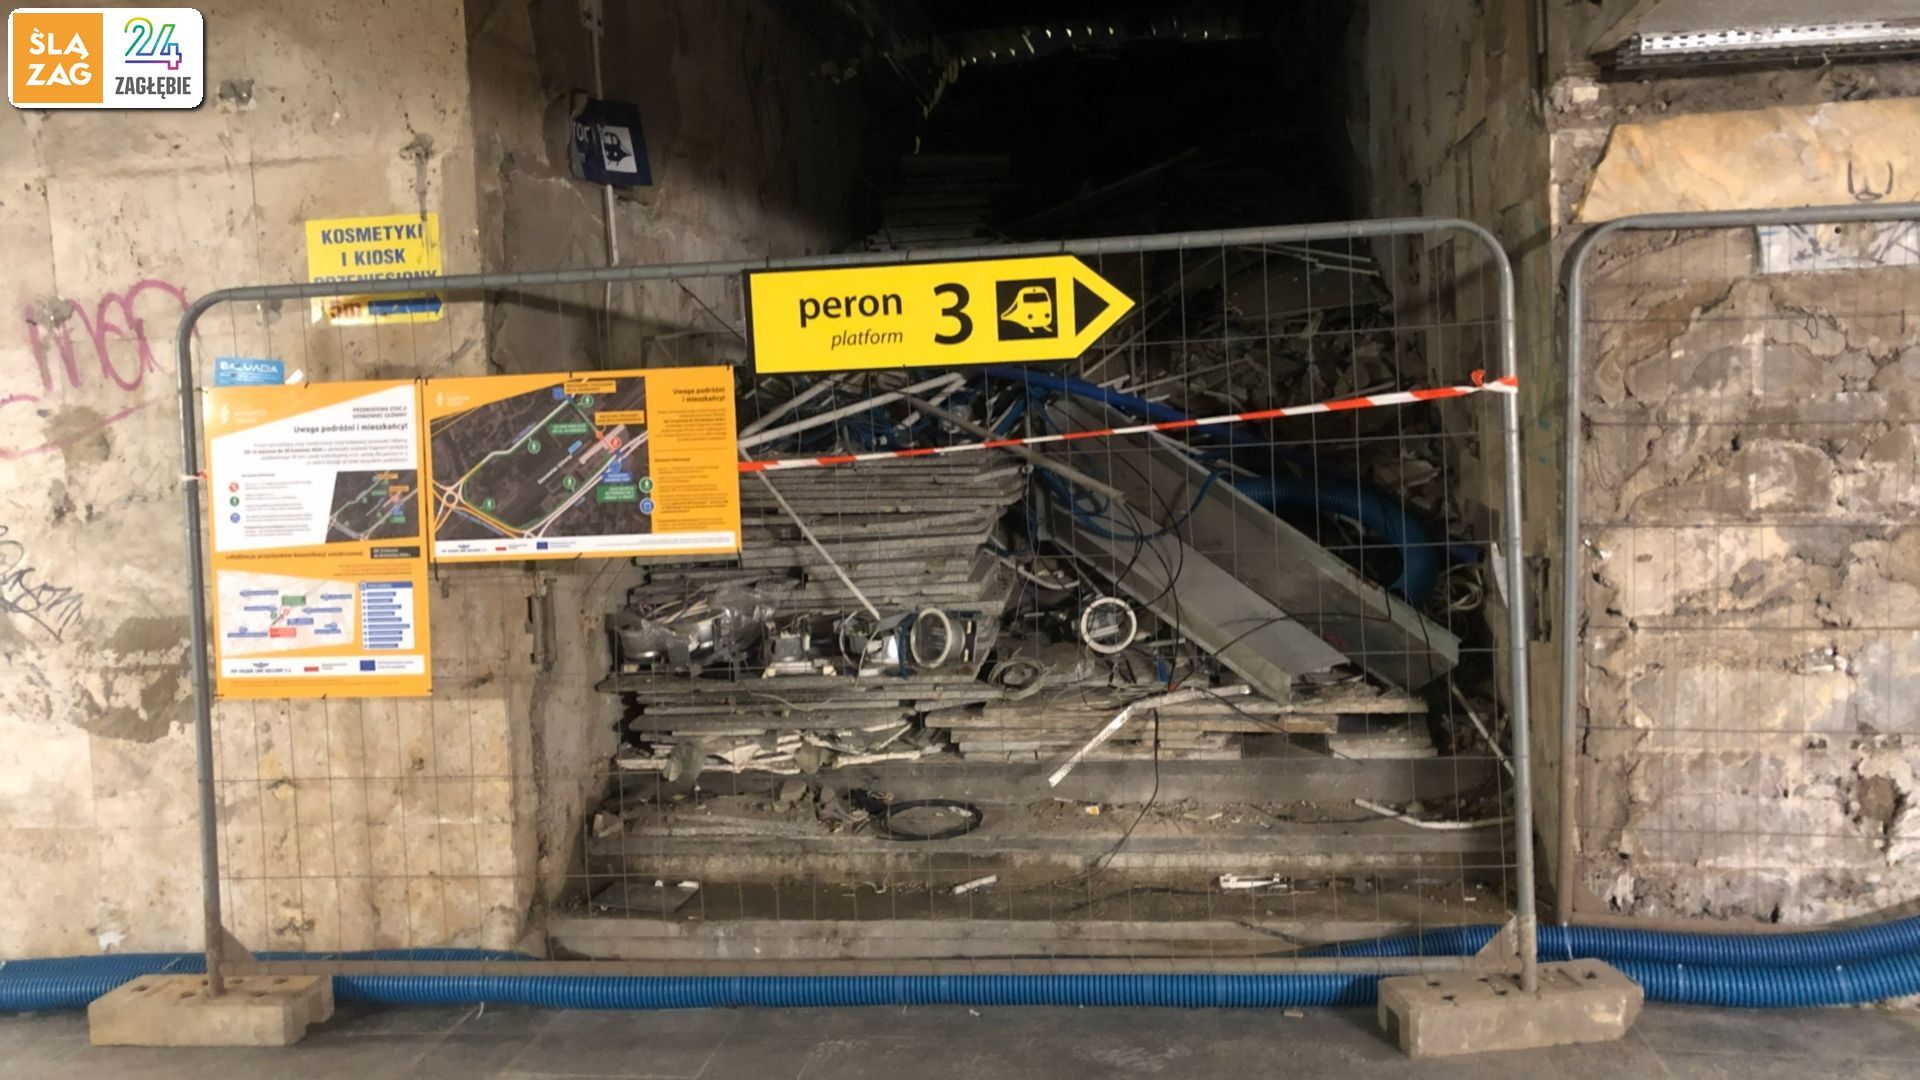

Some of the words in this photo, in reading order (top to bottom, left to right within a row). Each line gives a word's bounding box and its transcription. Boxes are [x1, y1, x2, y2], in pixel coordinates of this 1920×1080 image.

[321, 224, 423, 245] KOSMETYKI
[354, 248, 406, 266] KIOSK
[800, 293, 903, 328] peron
[934, 283, 973, 345] 3
[831, 329, 904, 350] platform
[293, 425, 320, 435] Uwaga
[321, 423, 355, 434] podróżni
[361, 421, 408, 431] mieszkańcy!
